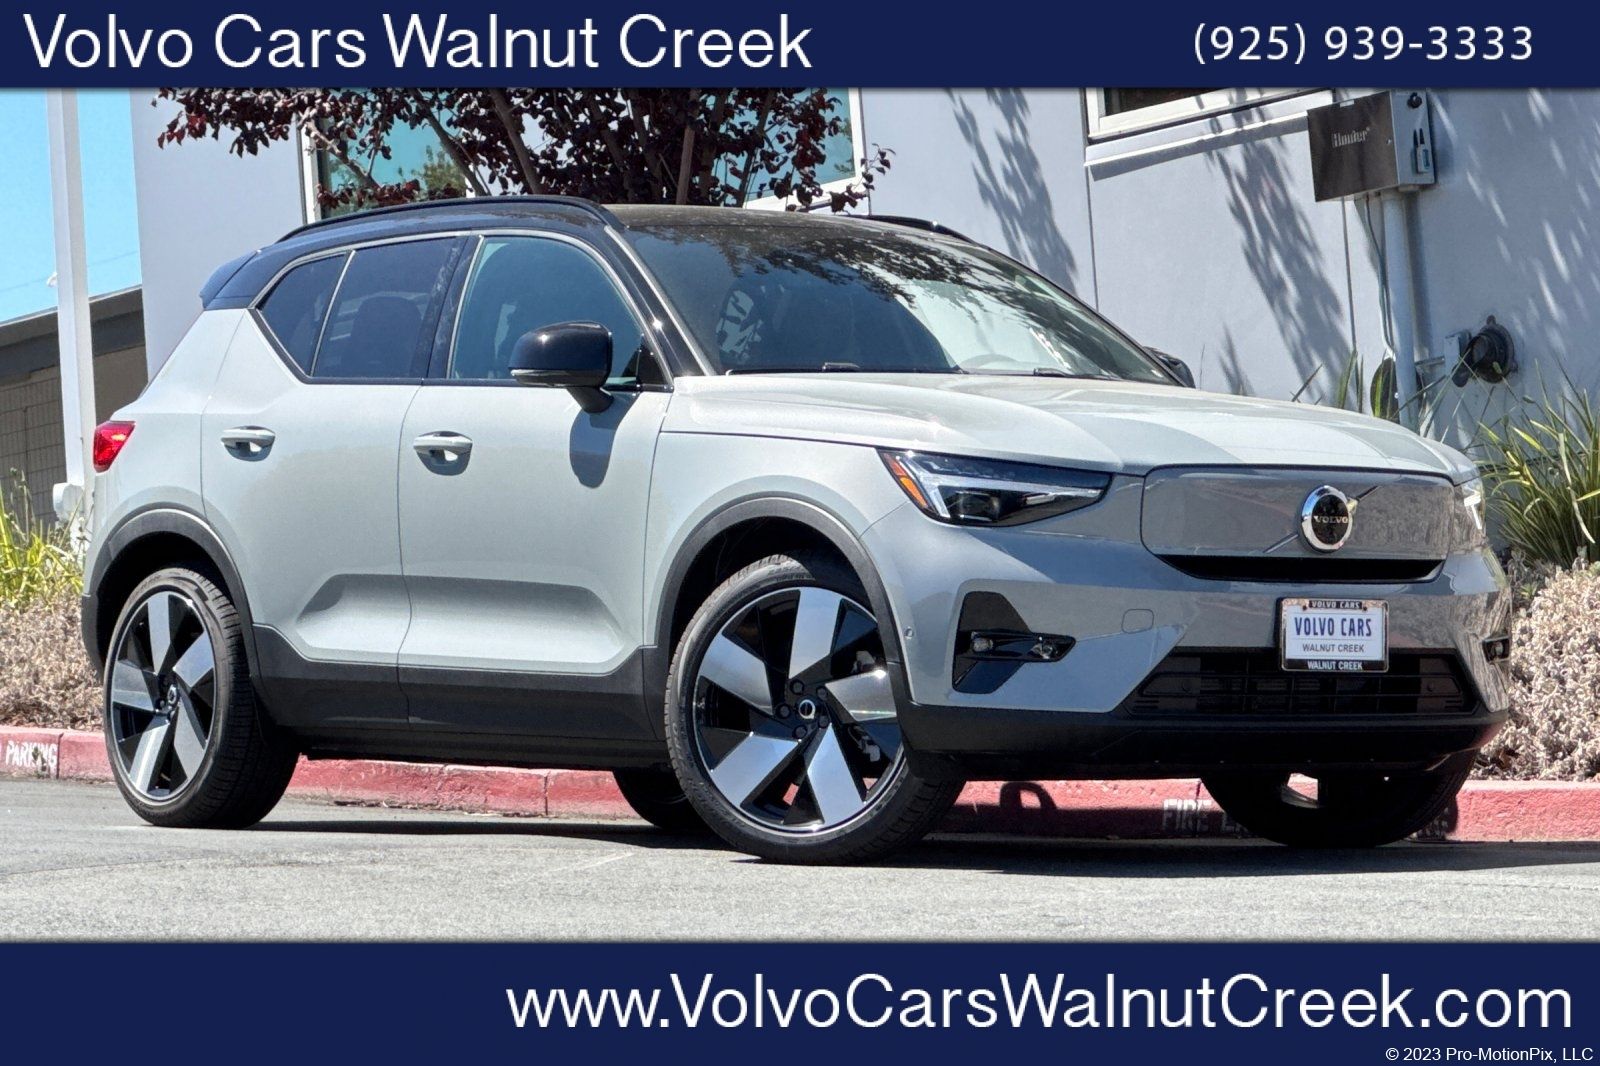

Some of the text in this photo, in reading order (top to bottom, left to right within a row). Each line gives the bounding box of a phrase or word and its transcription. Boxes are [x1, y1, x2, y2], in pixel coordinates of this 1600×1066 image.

[1313, 515, 1348, 524] VOLVO
[1311, 601, 1360, 609] VOLVO CARS
[1294, 617, 1372, 637] VOLVO CARS
[1302, 643, 1364, 653] WALNUT CREEK
[1307, 661, 1362, 670] WALNUT CREEK
[1162, 798, 1212, 832] FIRE
